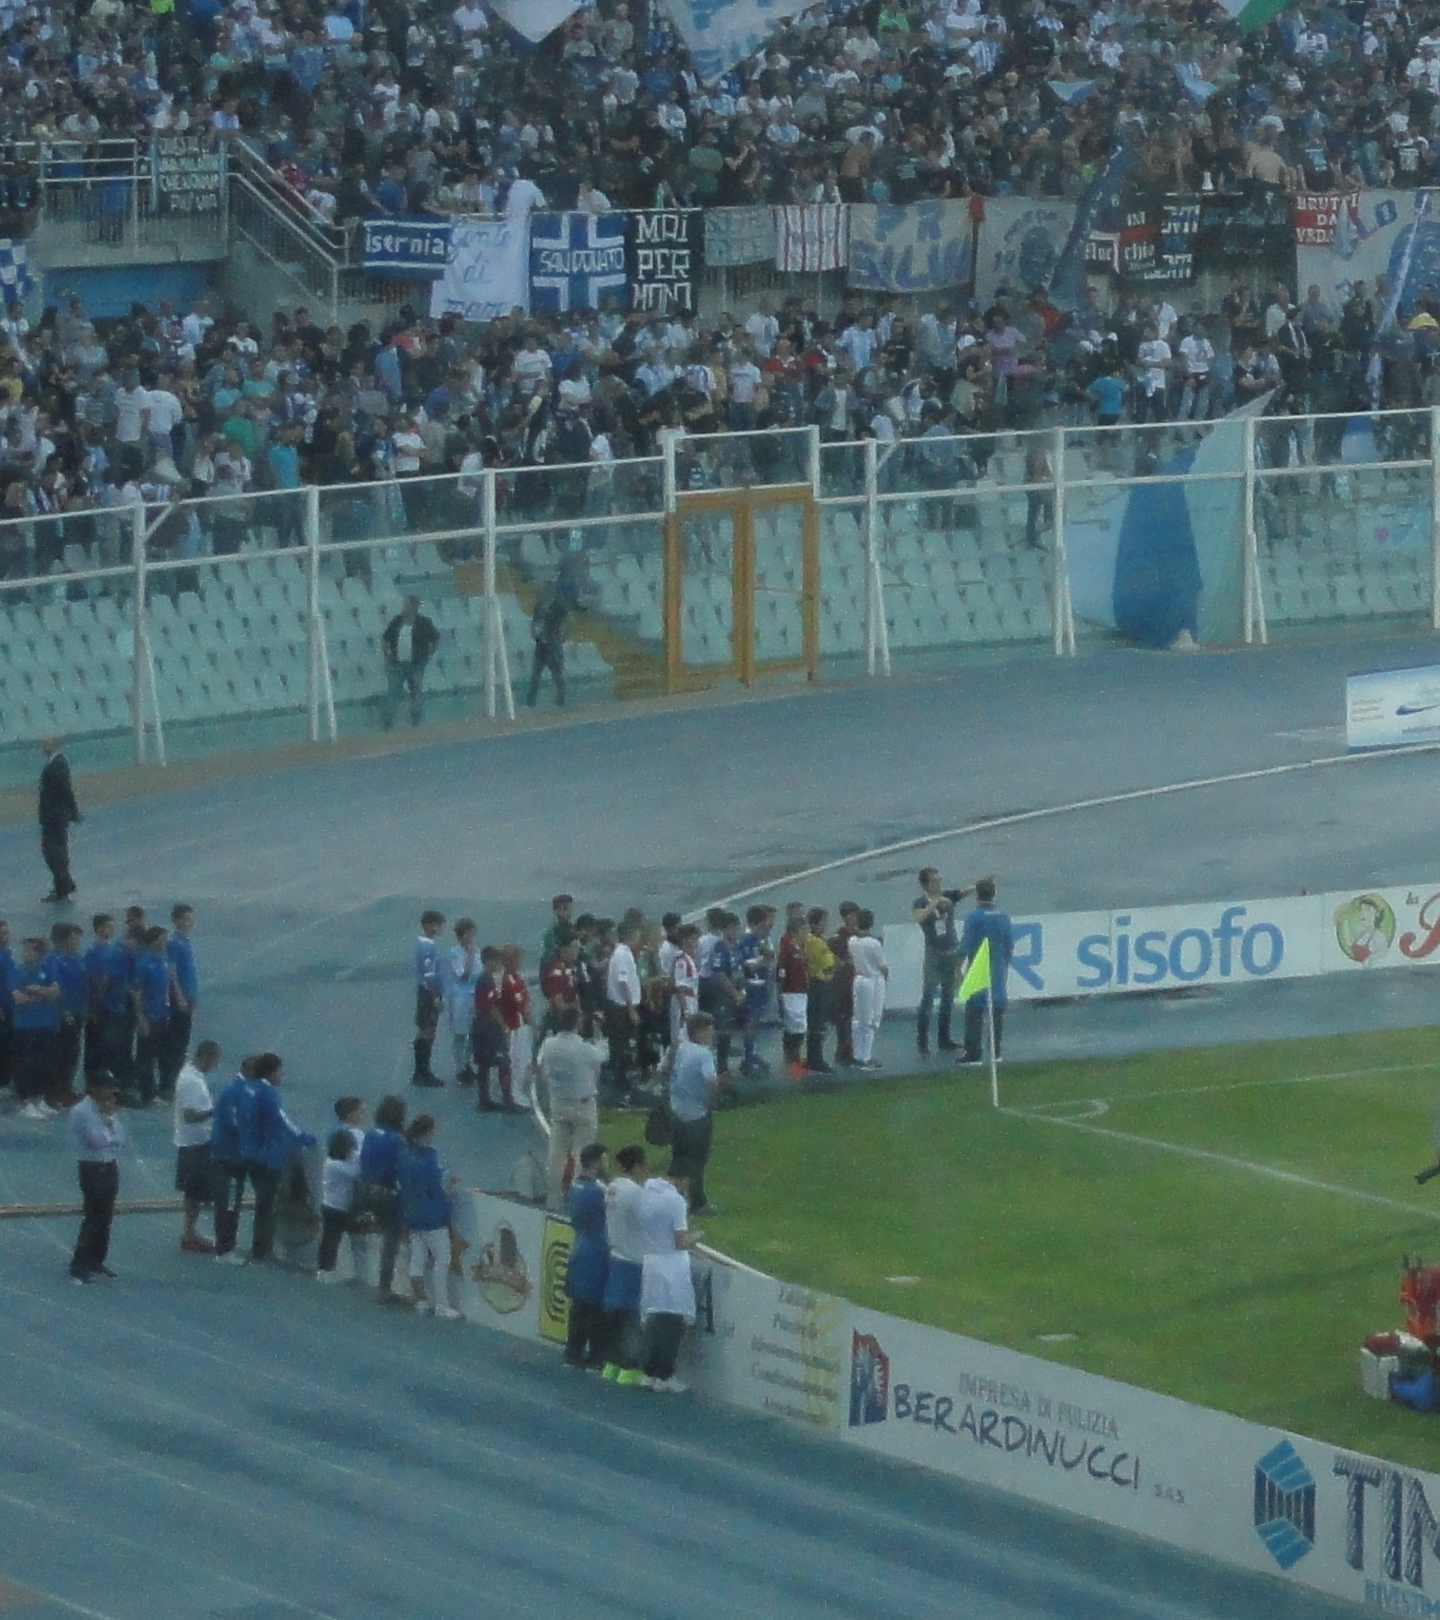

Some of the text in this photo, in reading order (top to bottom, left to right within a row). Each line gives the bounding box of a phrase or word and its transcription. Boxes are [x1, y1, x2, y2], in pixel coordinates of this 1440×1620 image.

[637, 249, 691, 280] PER
[1076, 905, 1285, 989] sisofo
[892, 1382, 1142, 1491] BERARDINUCCI
[959, 1371, 1031, 1414] IMPRESA
[1057, 1401, 1120, 1441] PULIZIA
